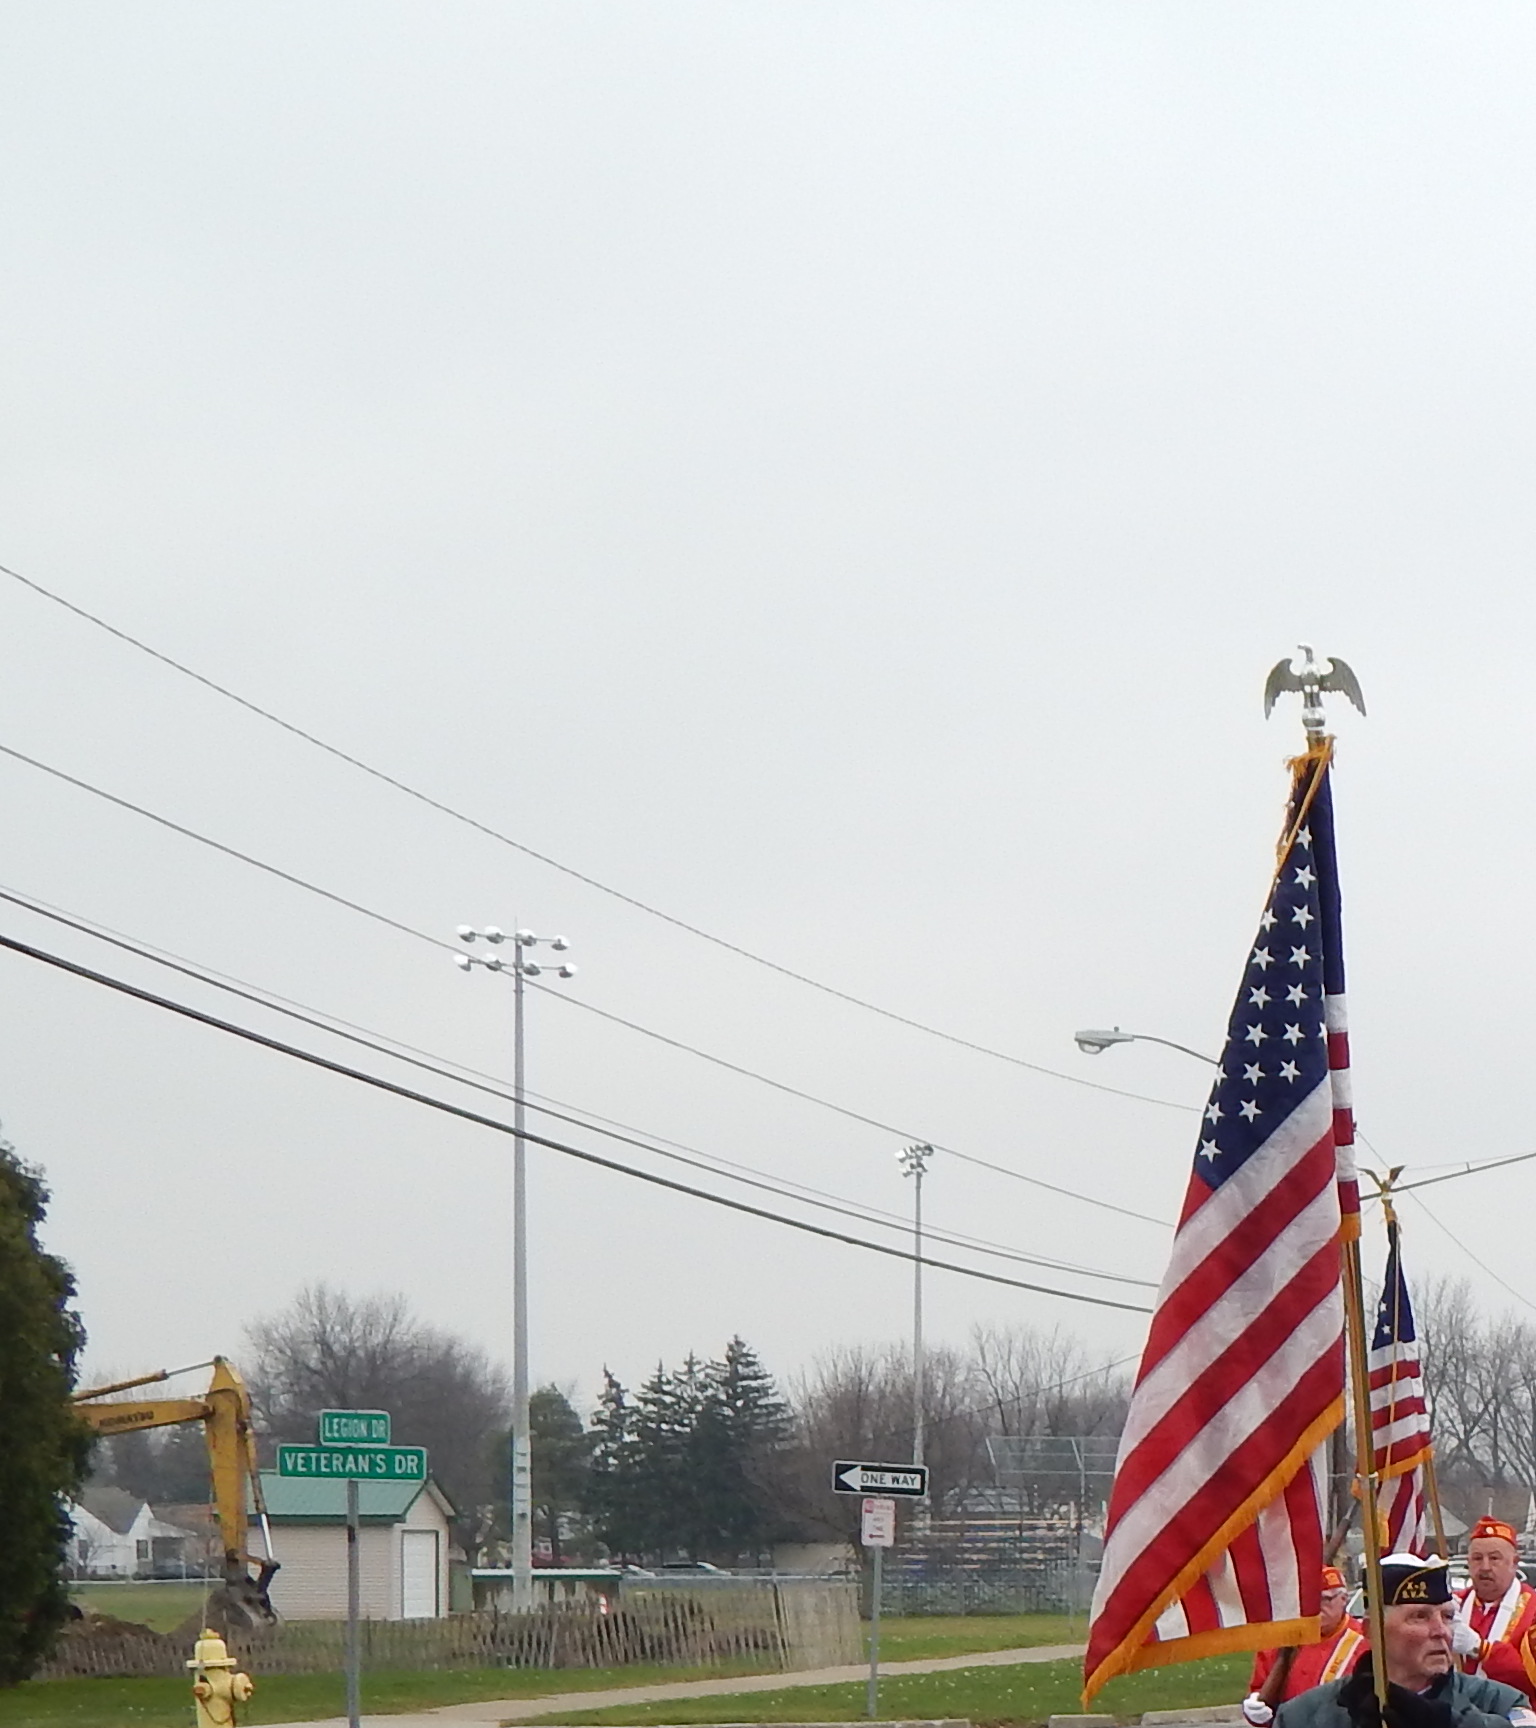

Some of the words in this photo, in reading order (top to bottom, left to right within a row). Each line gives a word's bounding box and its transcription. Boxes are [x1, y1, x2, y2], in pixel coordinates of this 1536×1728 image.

[324, 1417, 368, 1438] LEGION
[371, 1418, 386, 1438] DR
[284, 1452, 386, 1474] VETERAN'S
[394, 1454, 419, 1474] DR
[860, 1472, 886, 1485] ONE
[891, 1475, 917, 1486] WAY
